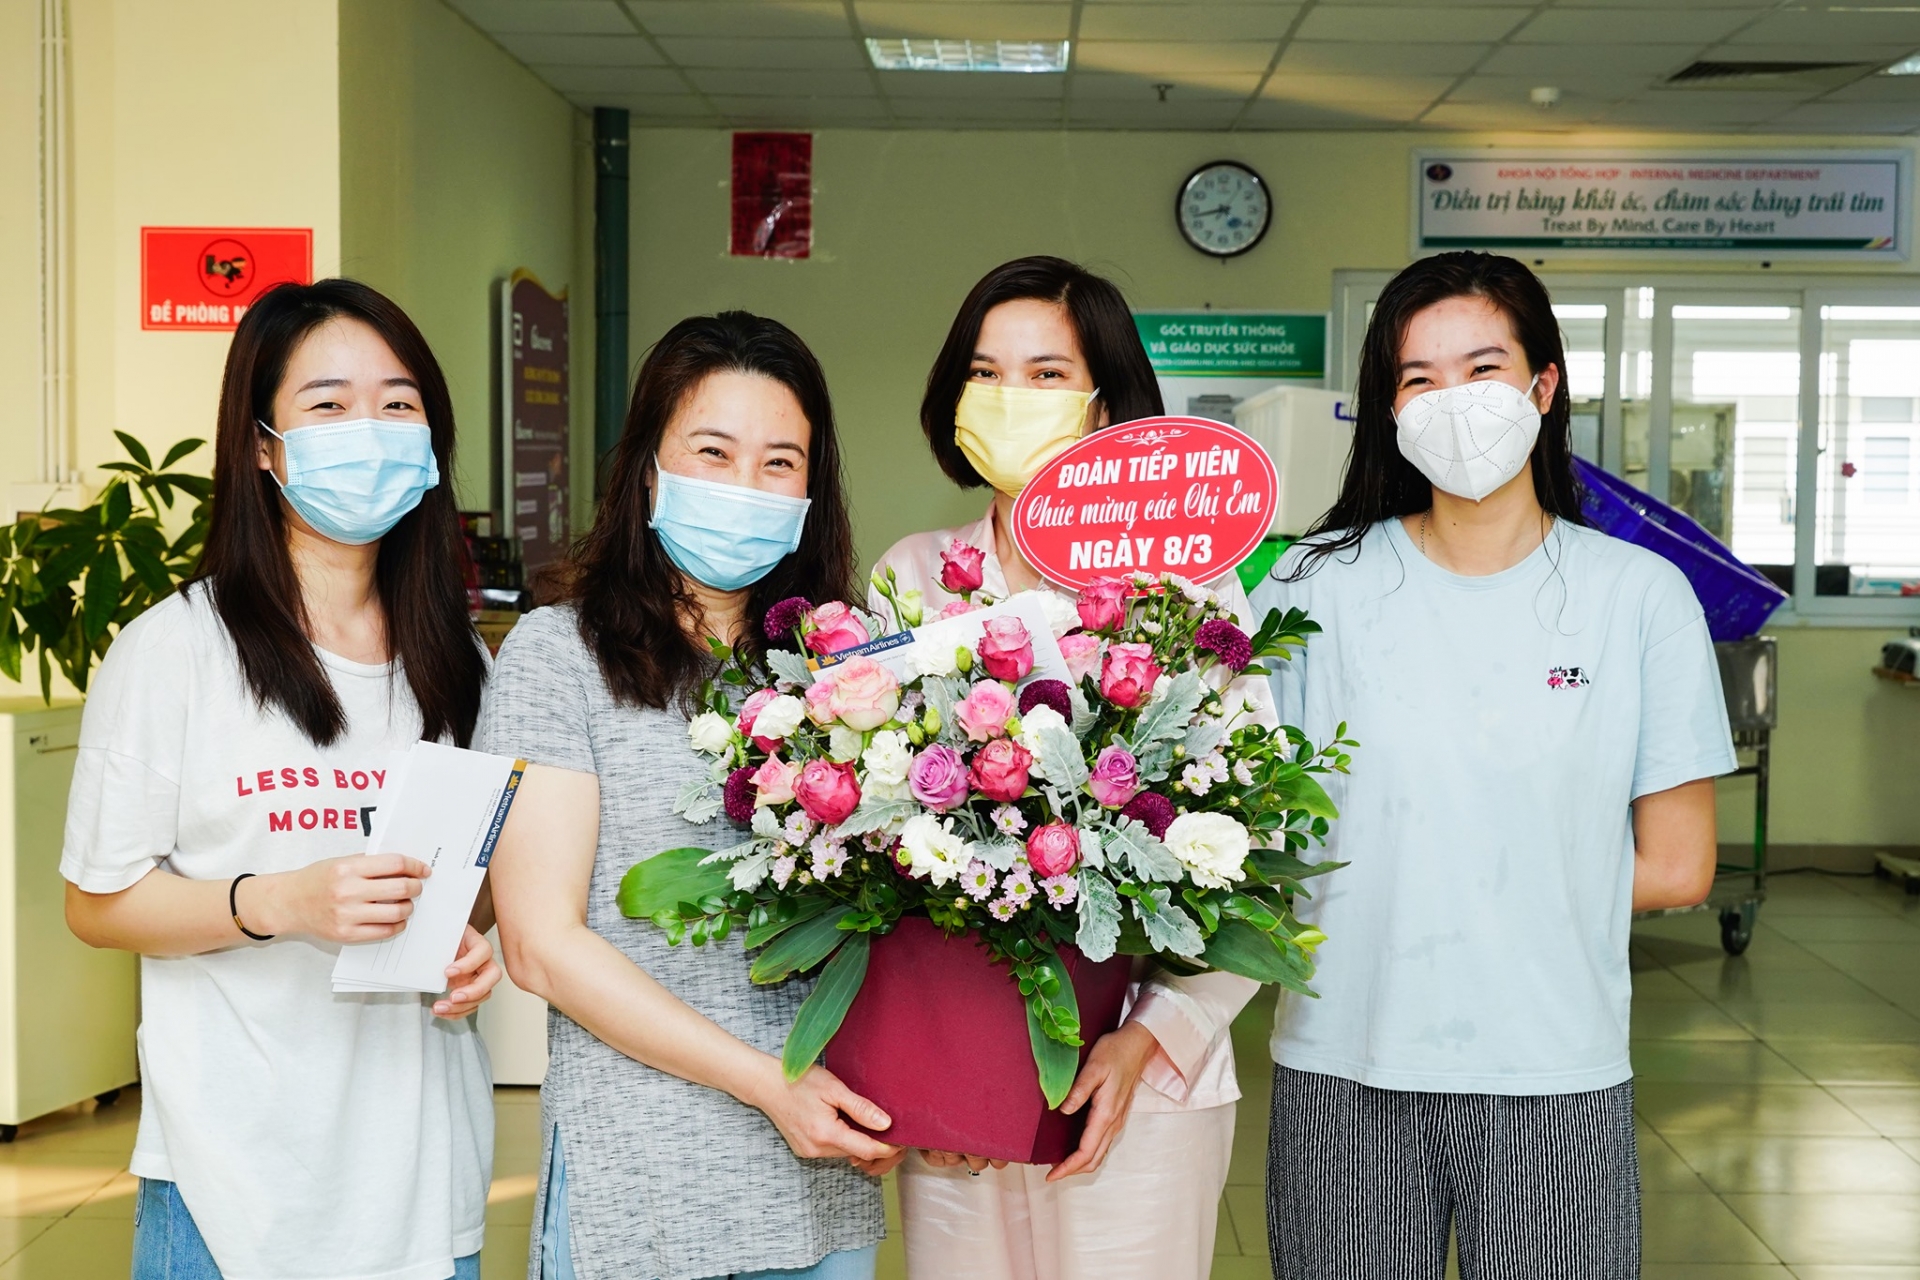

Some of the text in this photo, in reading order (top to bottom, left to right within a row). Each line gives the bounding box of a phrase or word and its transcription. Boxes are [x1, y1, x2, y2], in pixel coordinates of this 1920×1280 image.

[1431, 187, 1480, 211] Điều
[1487, 189, 1511, 214] trị
[1516, 187, 1566, 215] bằng
[1572, 187, 1616, 211] khối
[1654, 188, 1710, 212] chăm
[1714, 190, 1748, 212] sóc
[1752, 188, 1802, 218] bằng
[1808, 190, 1845, 212] trái
[1850, 191, 1884, 212] tim
[1543, 218, 1582, 232] Treat
[1587, 218, 1608, 236] By
[1662, 218, 1700, 233] Care
[1705, 218, 1726, 237] By
[1730, 218, 1775, 233] Heart
[175, 301, 230, 324] PHÒNG
[1160, 322, 1187, 336] GÓC
[1241, 322, 1286, 336] THÔNG
[1150, 341, 1167, 354] VÀ
[1170, 340, 1201, 354] GIÁO
[1204, 341, 1229, 356] DỤC
[1233, 340, 1257, 354] SỨC
[1057, 445, 1240, 488] ĐOÀN TIẾP VIÊN
[1026, 480, 1262, 531] Chúc mừng các Chị Em
[1069, 533, 1213, 570] NGÀY 8/3
[236, 767, 386, 797] LESS BOY
[269, 808, 358, 832] MORE
